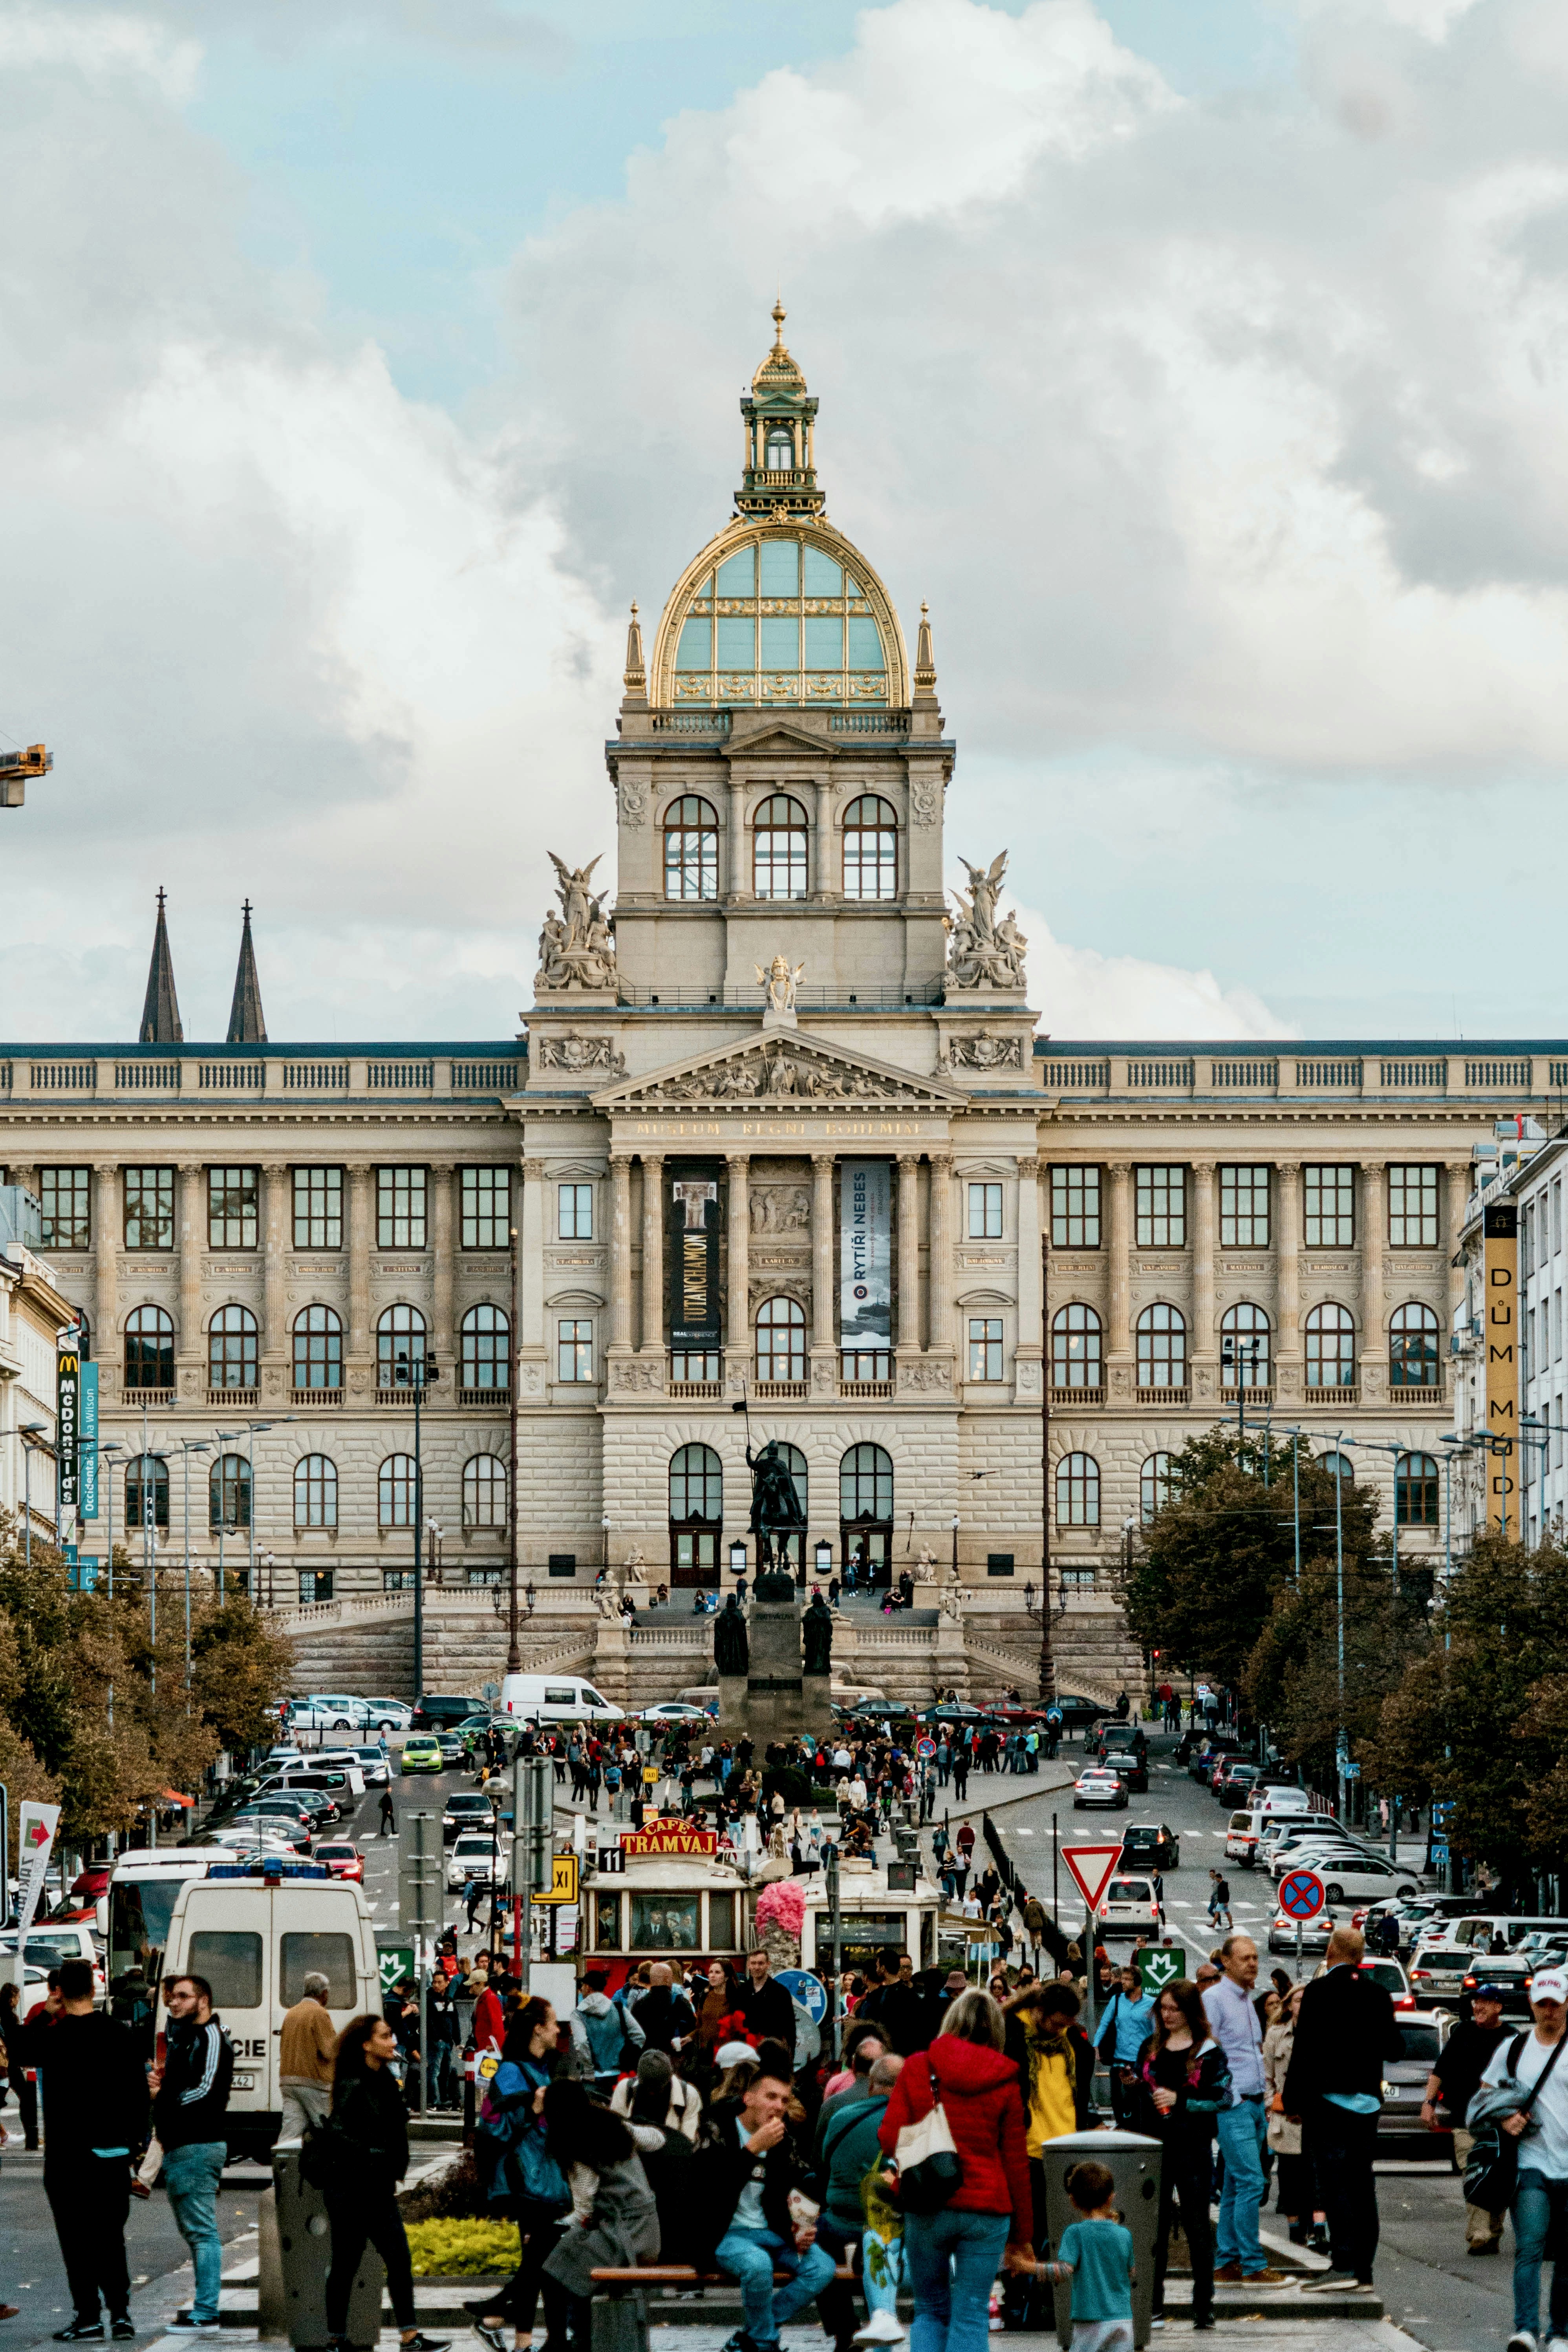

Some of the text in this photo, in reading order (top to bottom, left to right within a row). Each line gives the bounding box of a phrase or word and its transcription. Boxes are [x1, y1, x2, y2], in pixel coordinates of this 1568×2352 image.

[638, 1123, 923, 1135] MUSEUM REGNI BOHEMIAE
[851, 1173, 865, 1279] RYTÍŘI NEBES
[683, 1234, 707, 1322] TUTANCHAMON
[85, 1388, 94, 1419] Wilson
[645, 1820, 690, 1835] CAFE
[622, 1836, 714, 1854] TRAMVAJ
[604, 1850, 620, 1871] 11
